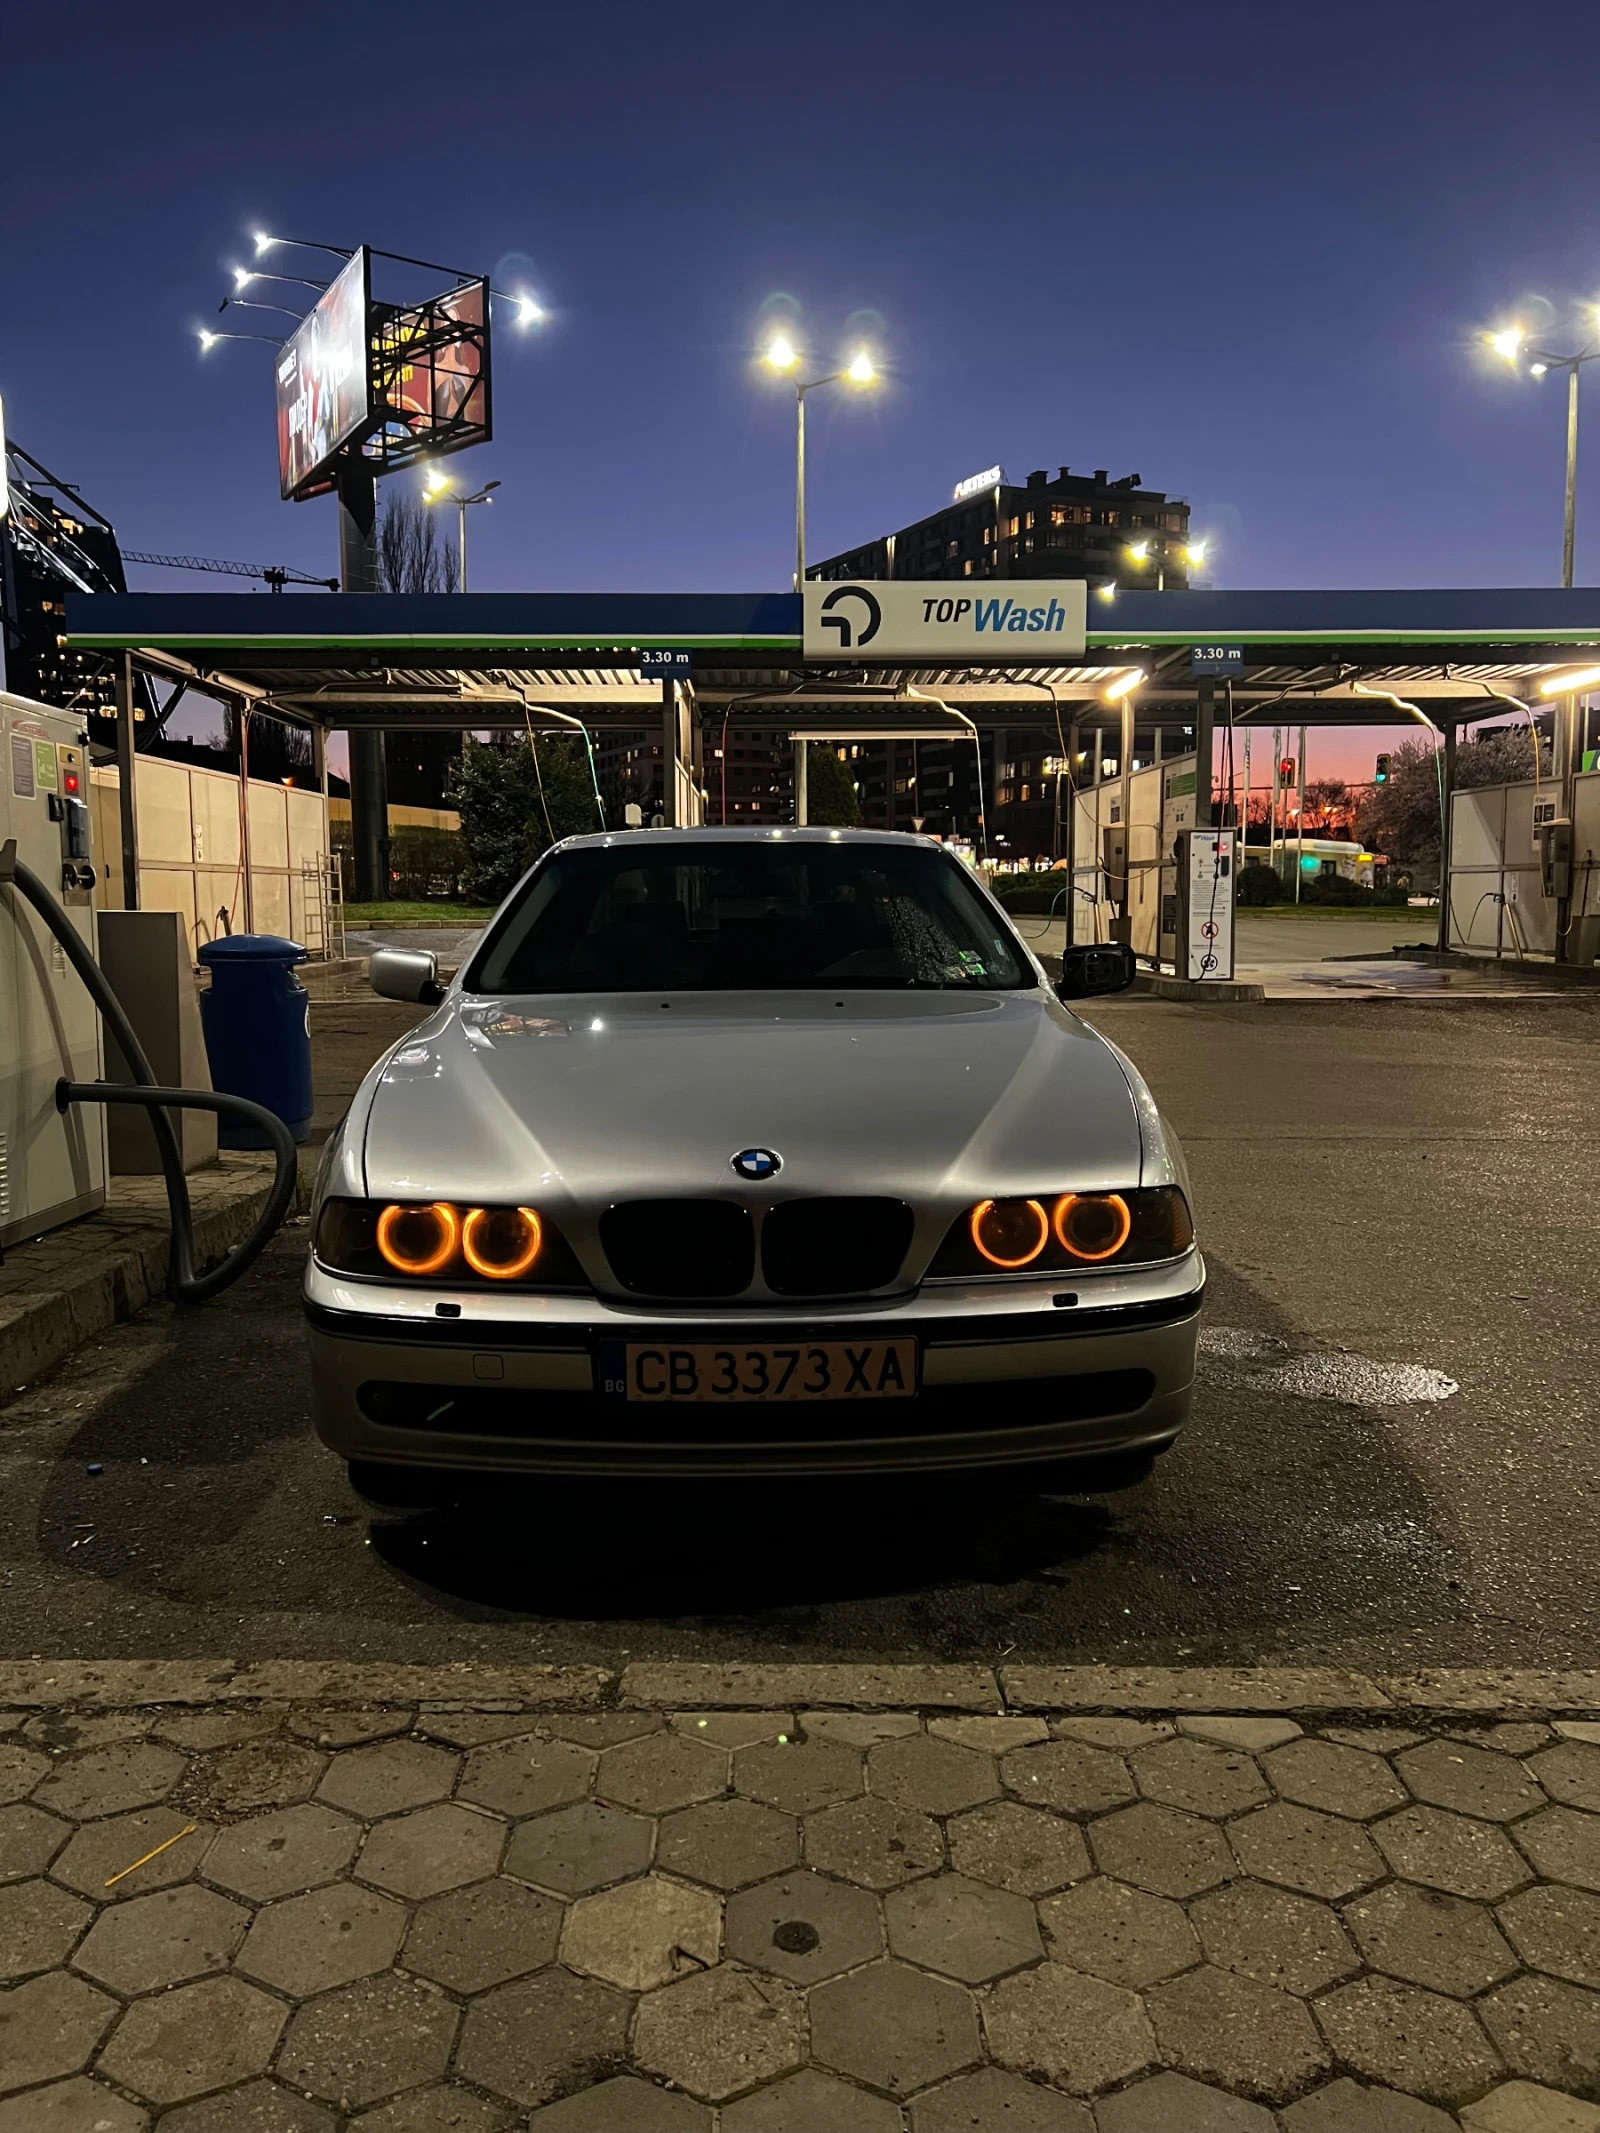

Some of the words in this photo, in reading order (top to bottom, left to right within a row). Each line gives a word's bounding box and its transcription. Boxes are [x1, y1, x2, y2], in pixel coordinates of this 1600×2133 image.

[922, 598, 972, 623] TOP
[975, 598, 1066, 632] Wash
[642, 651, 672, 663] 3.30
[676, 654, 689, 663] m
[1194, 647, 1224, 659] 3.30
[1228, 650, 1241, 659] m
[636, 1350, 699, 1395] CB
[711, 1348, 832, 1395] 3373
[843, 1346, 906, 1393] XA
[604, 1379, 625, 1393] BG
